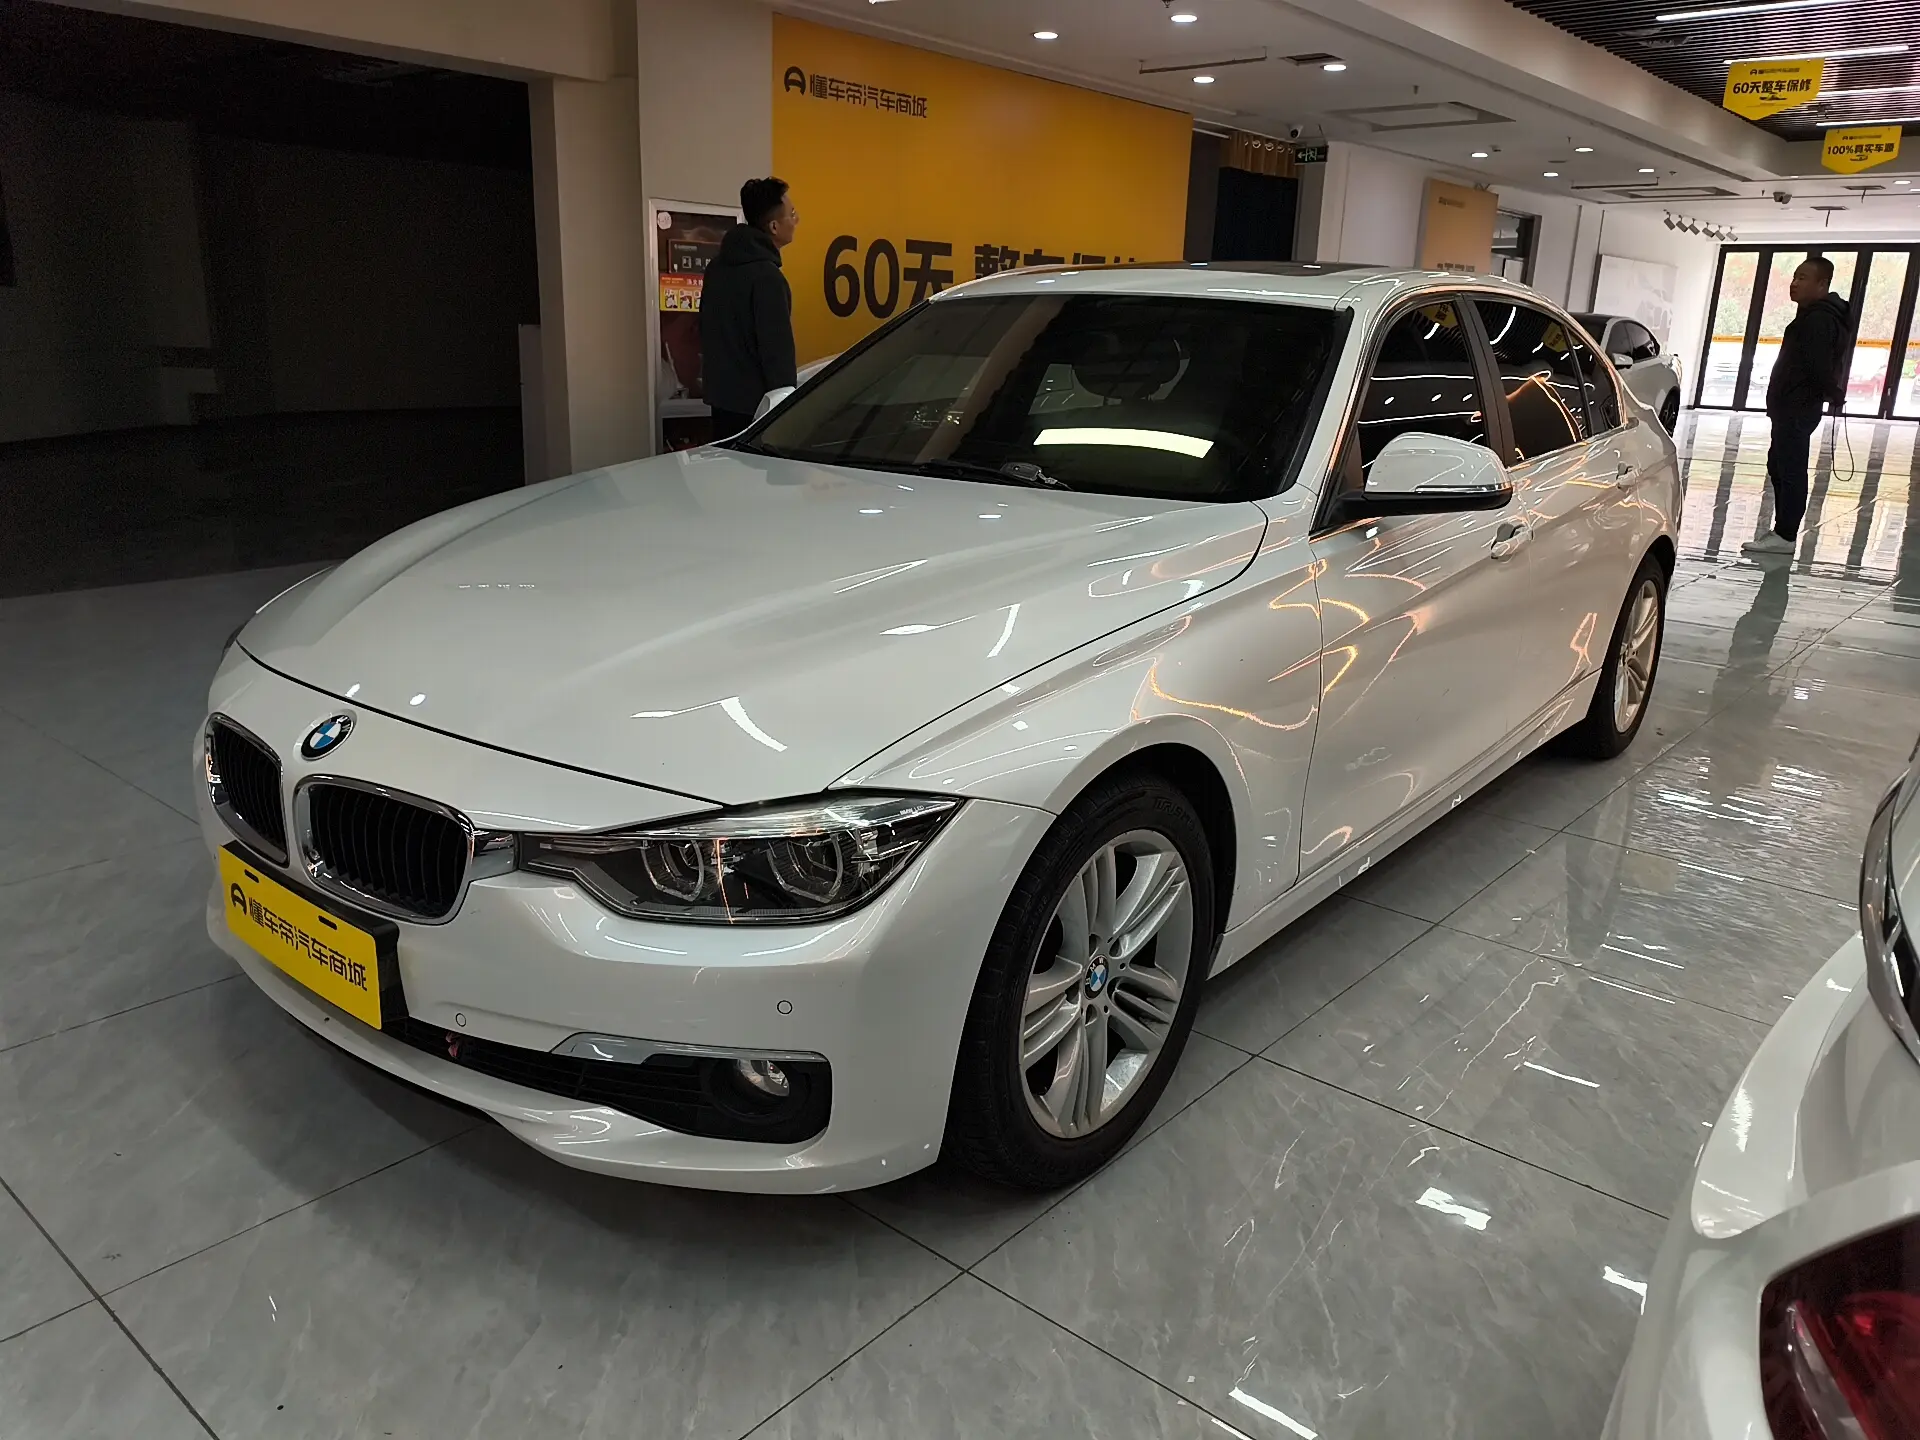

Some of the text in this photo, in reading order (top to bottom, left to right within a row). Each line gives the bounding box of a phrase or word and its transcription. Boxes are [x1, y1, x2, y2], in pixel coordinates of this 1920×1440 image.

[809, 73, 928, 119] 懂车帝汽车商城
[1732, 78, 1813, 94] 60天整车保修
[822, 234, 954, 320] 60天
[248, 897, 368, 991] 懂车帝汽车商城
